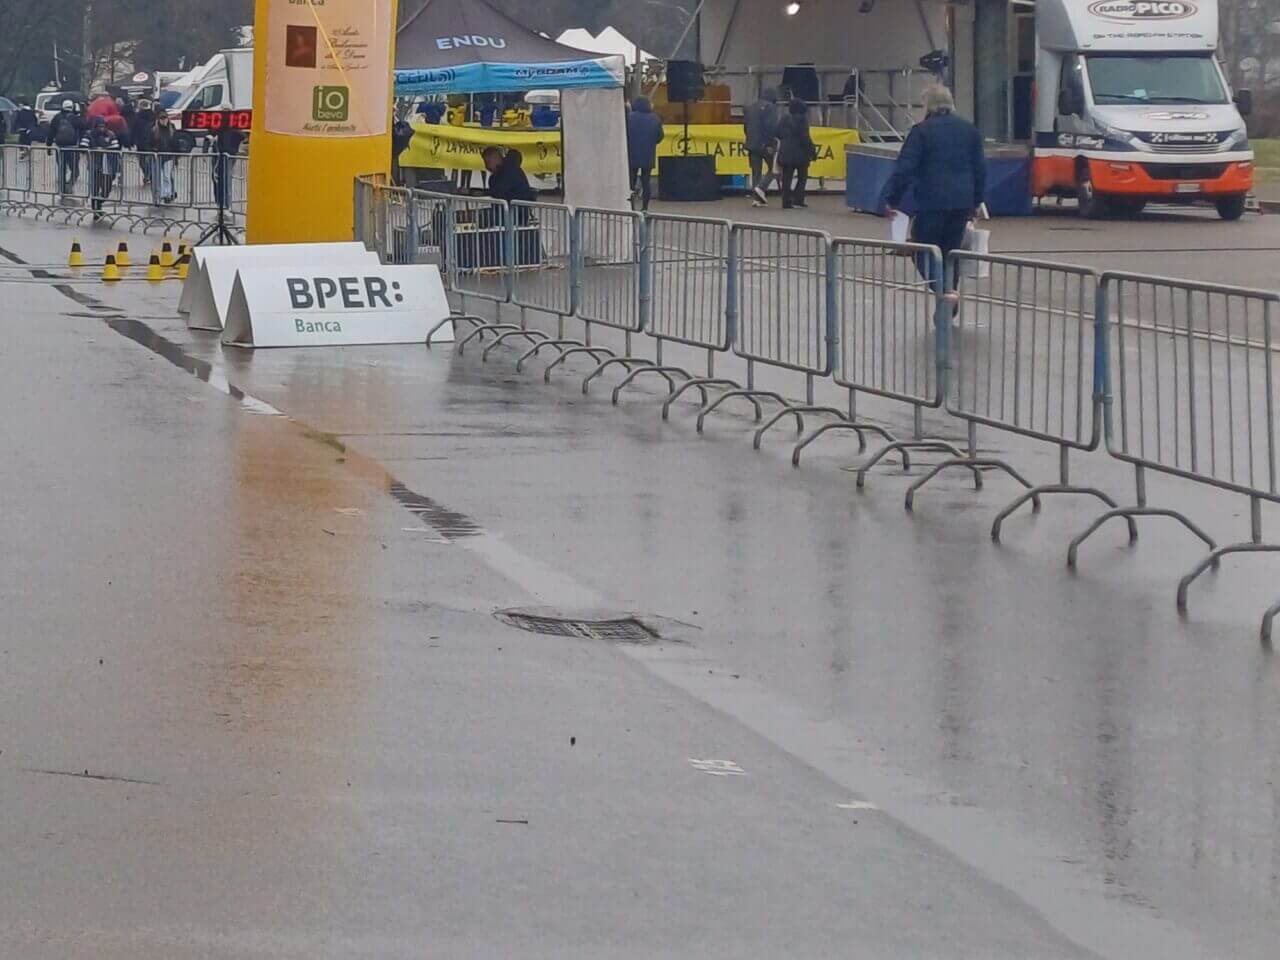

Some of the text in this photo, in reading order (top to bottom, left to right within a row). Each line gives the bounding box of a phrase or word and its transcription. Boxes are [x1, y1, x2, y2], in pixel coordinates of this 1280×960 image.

[1099, 2, 1185, 15] RADIO PICO
[435, 34, 507, 50] ENDU
[189, 111, 250, 129] 13:01:0
[286, 276, 404, 309] BPER:
[295, 318, 341, 333] Banca
